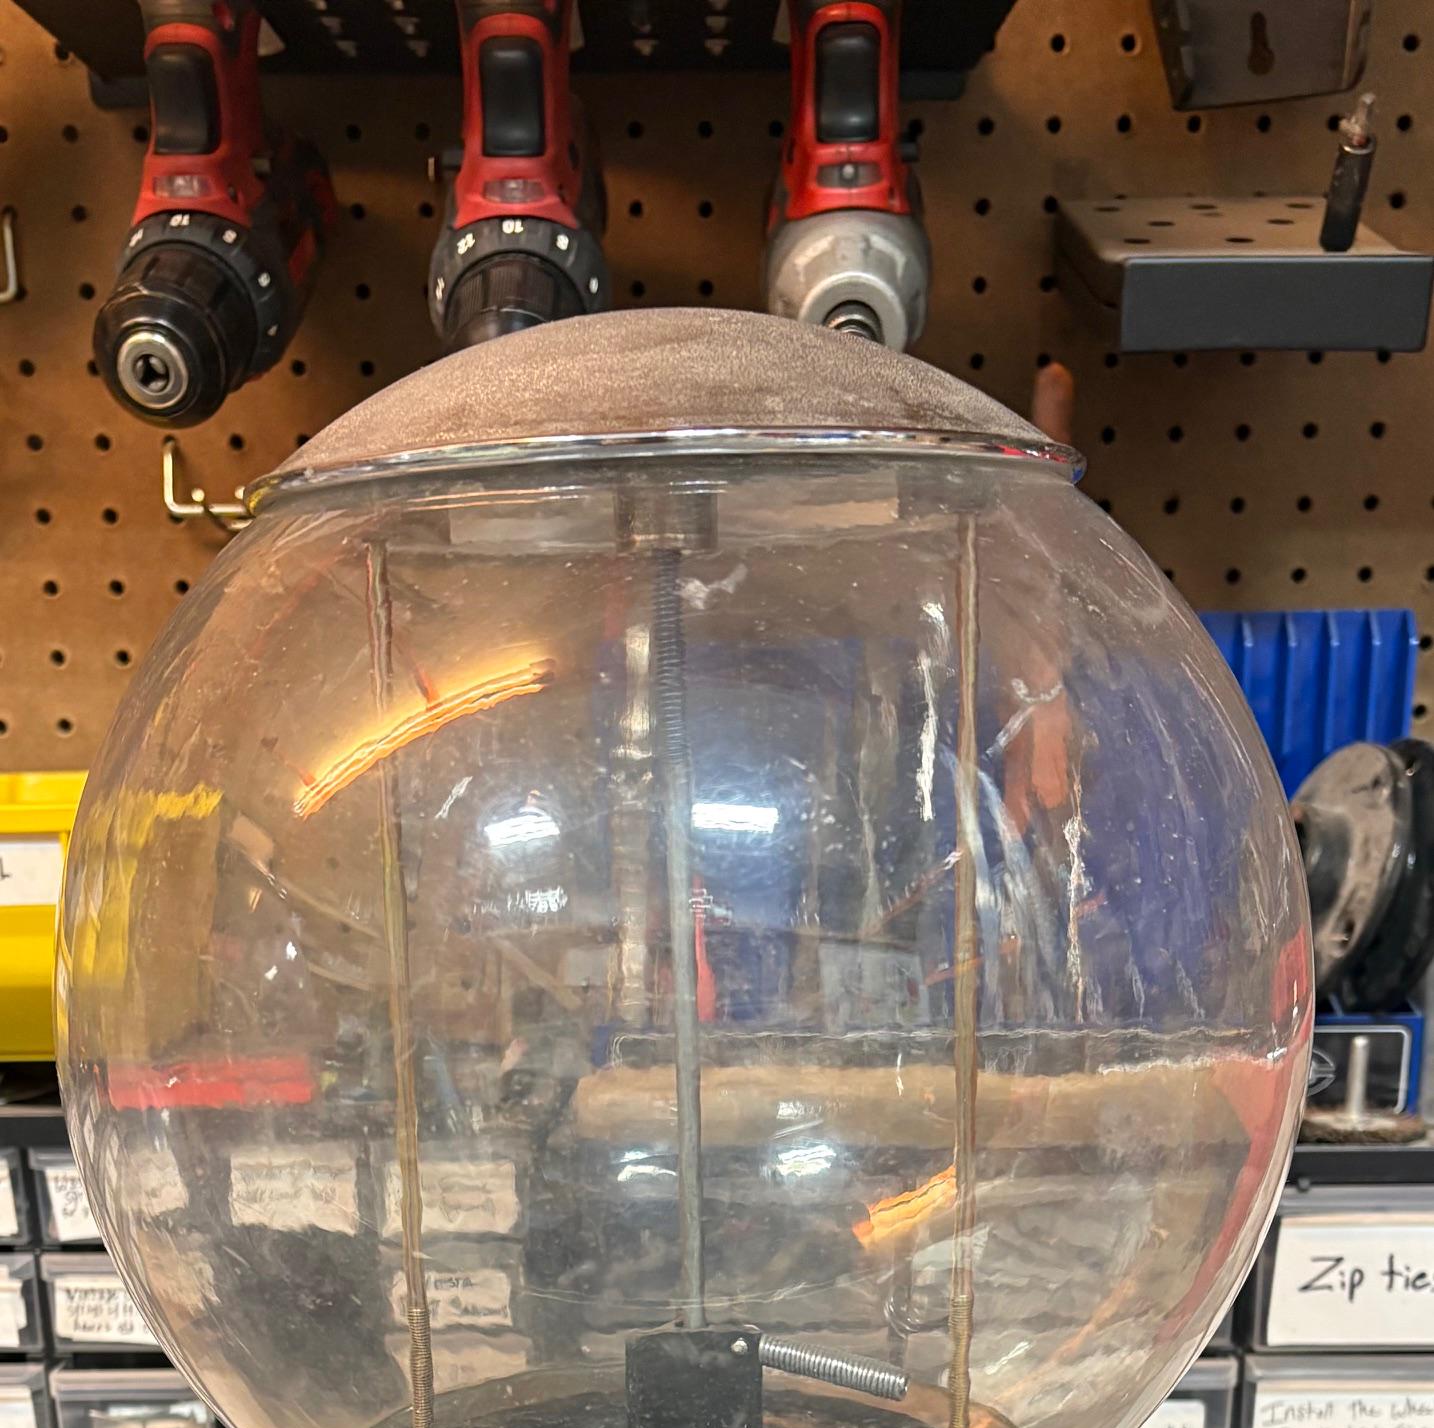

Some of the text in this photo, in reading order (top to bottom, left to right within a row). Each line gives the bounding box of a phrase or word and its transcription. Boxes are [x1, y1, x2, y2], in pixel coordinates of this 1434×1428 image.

[168, 213, 191, 227] 10
[501, 218, 524, 234] 10
[456, 232, 476, 255] 12
[1297, 1256, 1365, 1304] Zip
